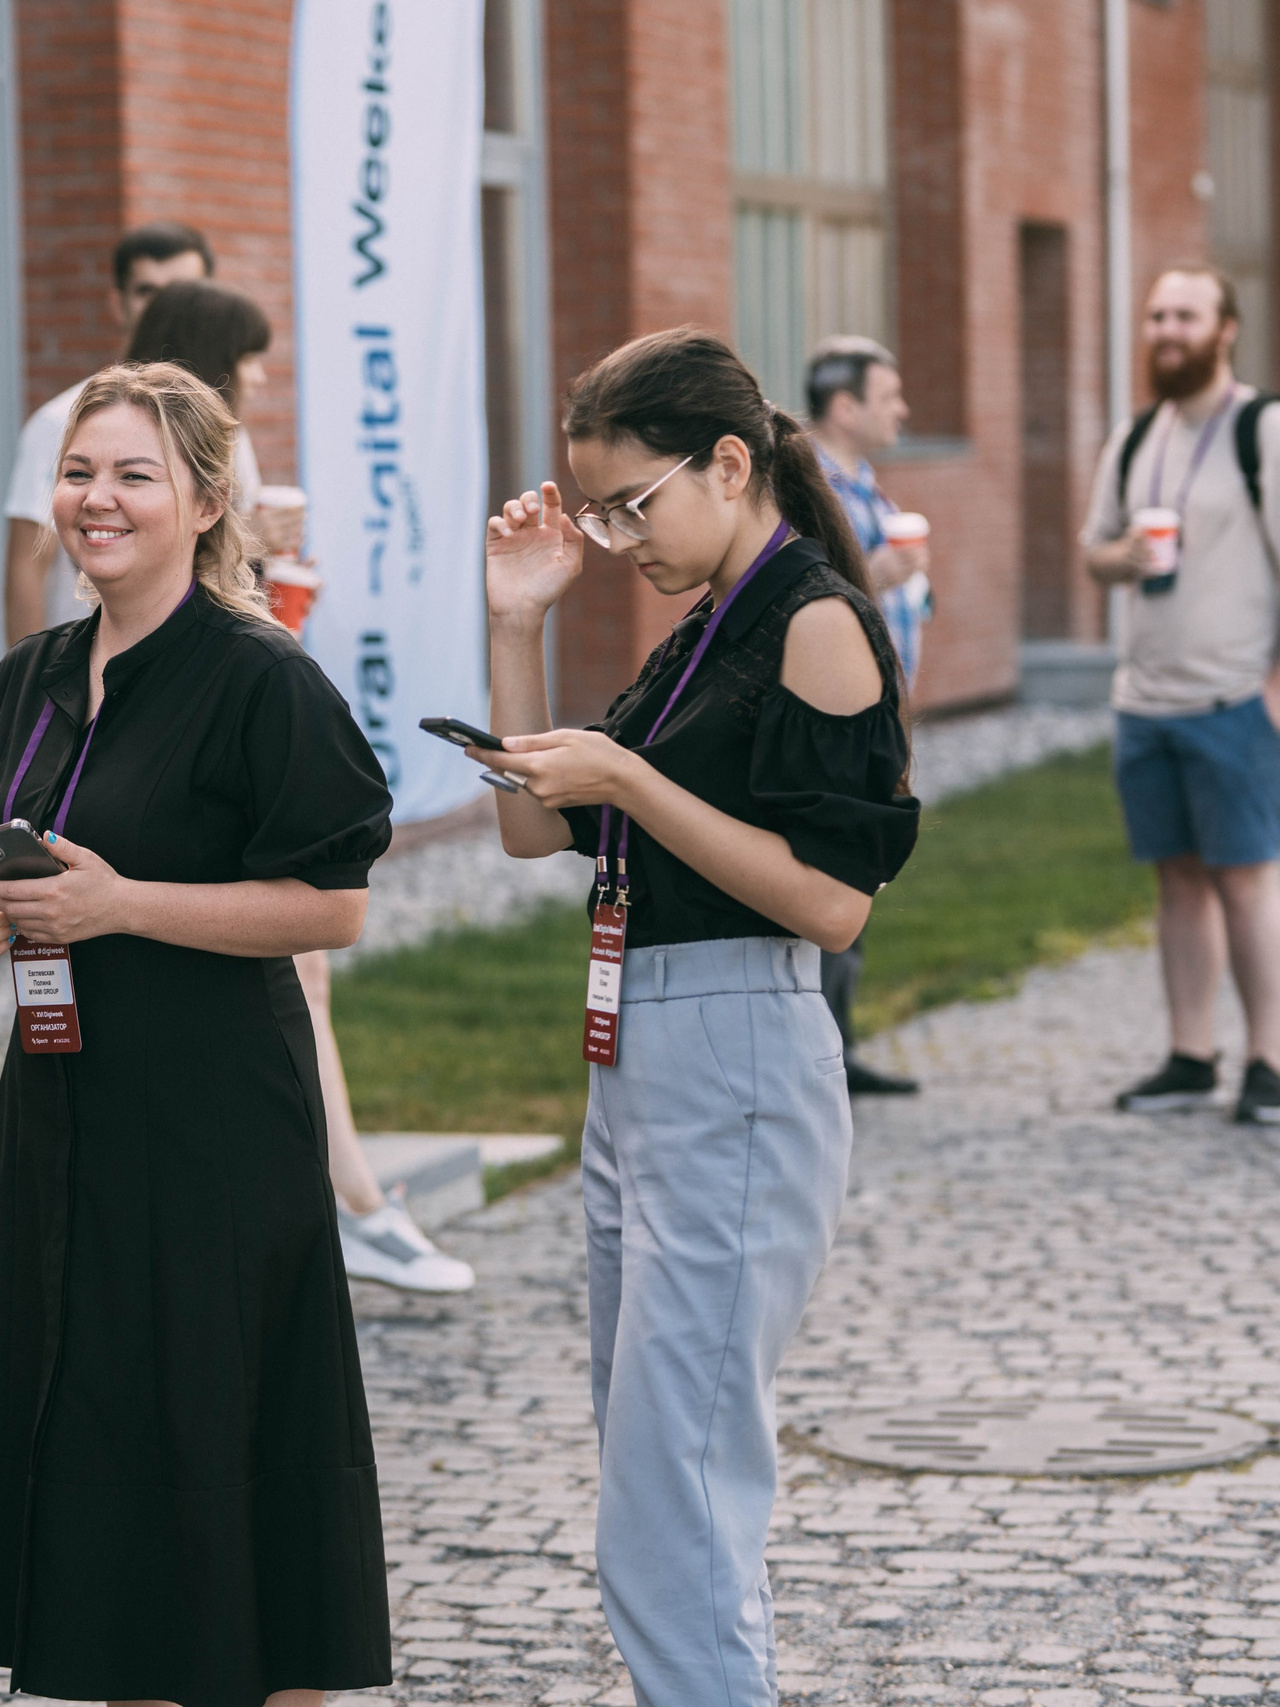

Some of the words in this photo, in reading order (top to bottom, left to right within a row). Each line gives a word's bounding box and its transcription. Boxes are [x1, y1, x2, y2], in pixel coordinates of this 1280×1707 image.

[37, 946, 65, 956] #digiweek
[43, 987, 59, 995] GROUP
[30, 1023, 68, 1032] ОРГАНИЗАТОР
